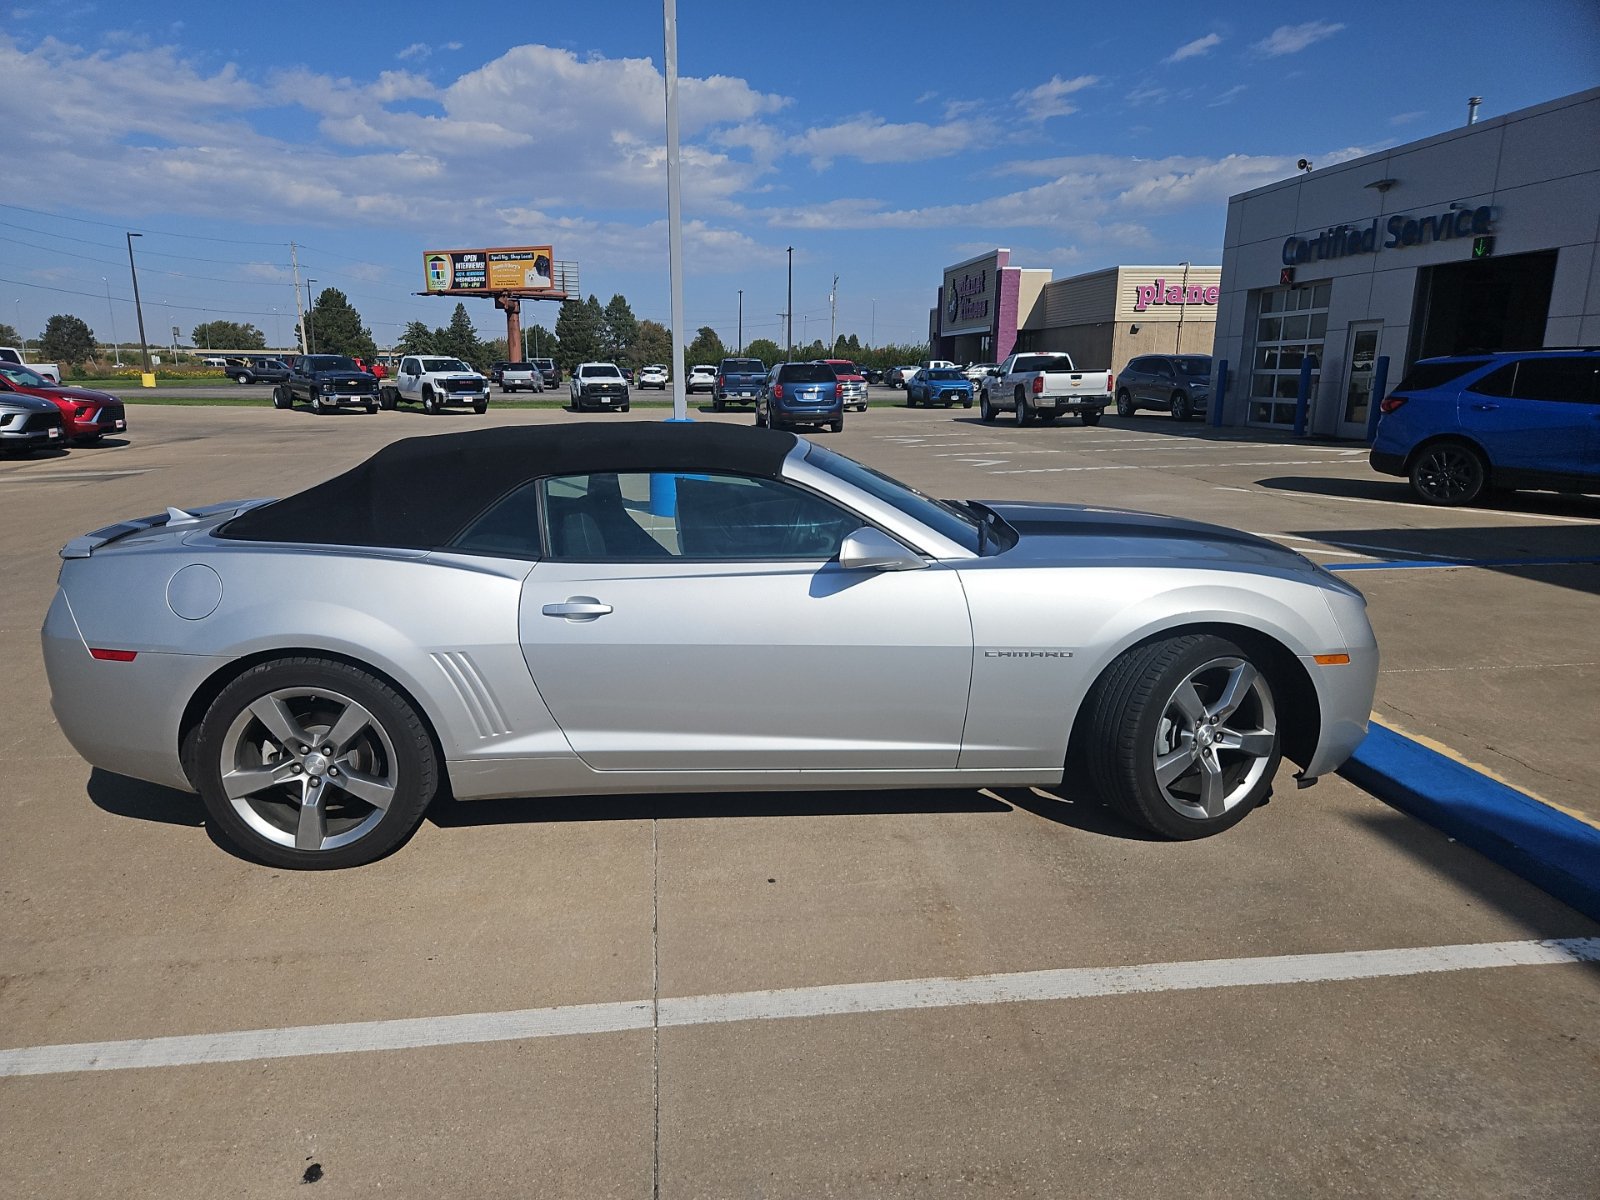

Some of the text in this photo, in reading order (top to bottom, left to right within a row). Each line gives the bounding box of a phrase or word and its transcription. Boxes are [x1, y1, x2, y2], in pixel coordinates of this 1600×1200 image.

[1282, 203, 1499, 266] Certified Service
[984, 650, 1074, 658] CAMARO
